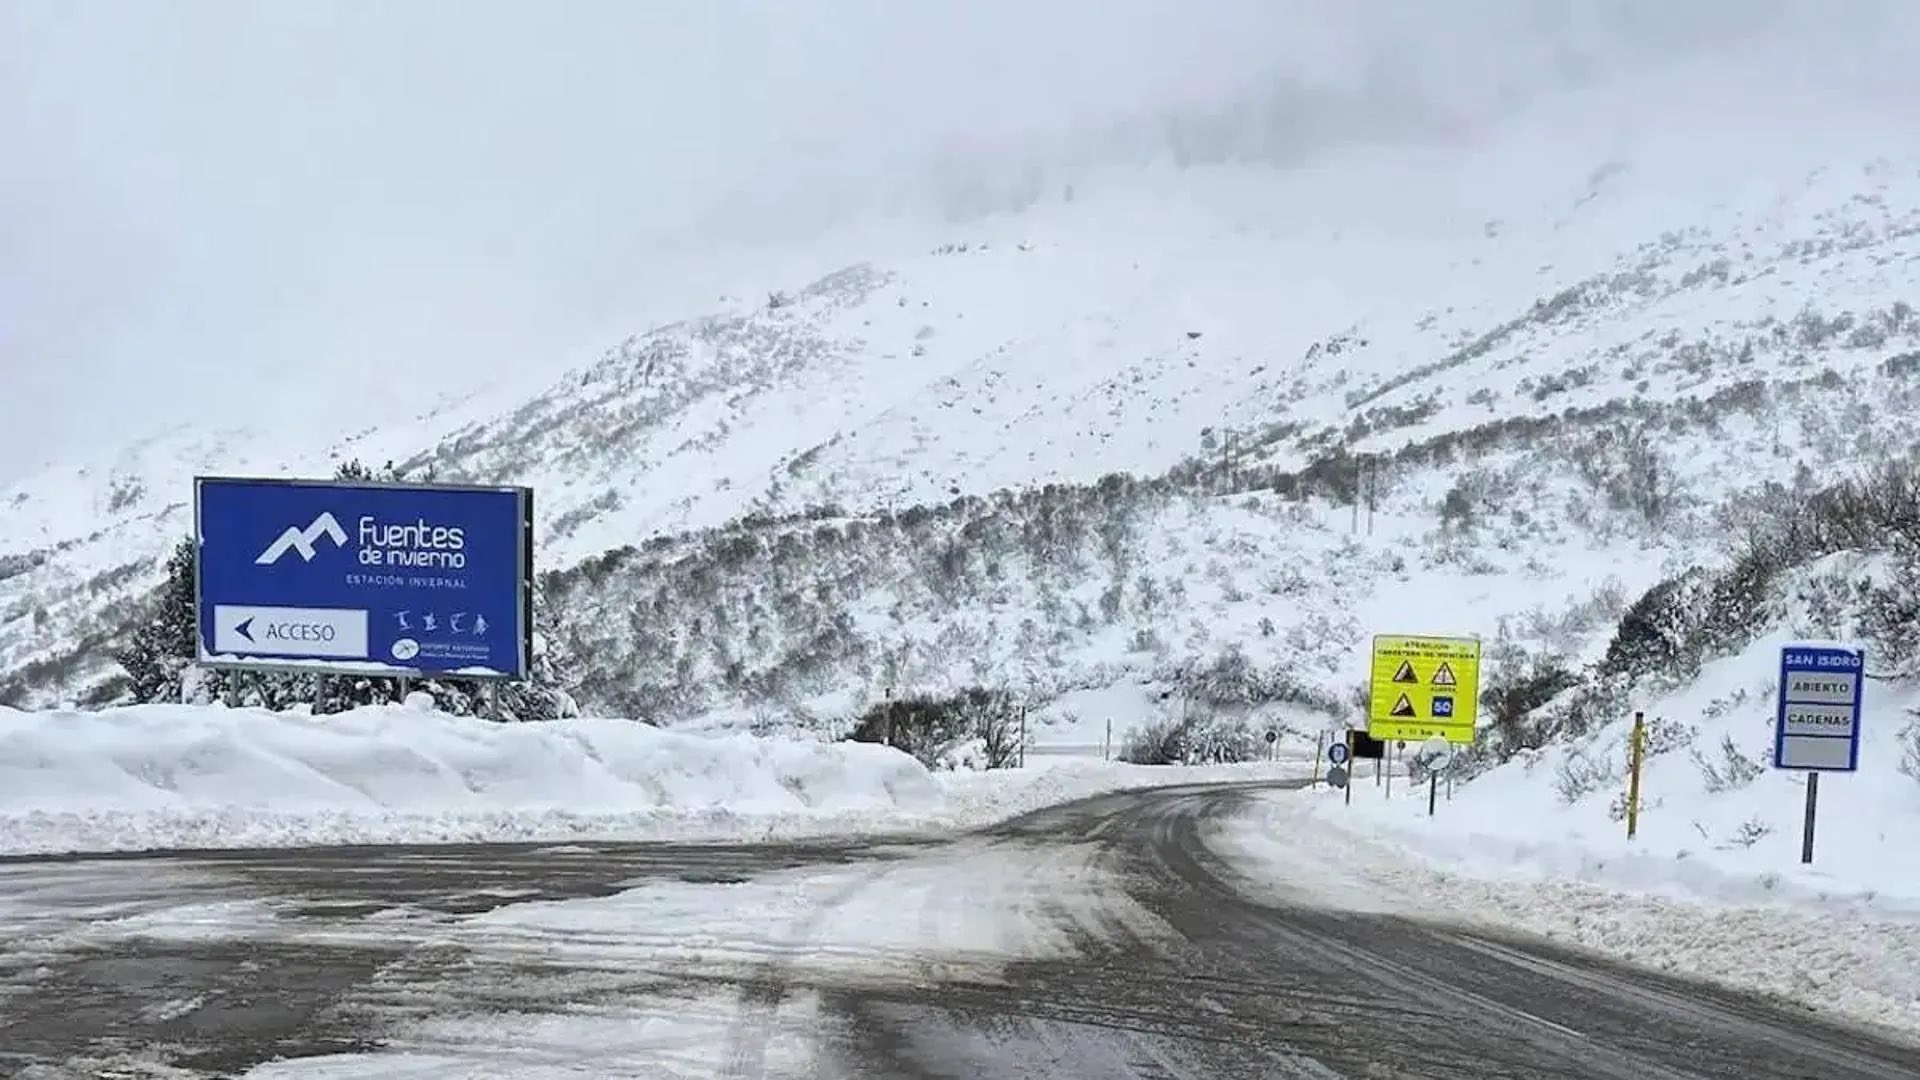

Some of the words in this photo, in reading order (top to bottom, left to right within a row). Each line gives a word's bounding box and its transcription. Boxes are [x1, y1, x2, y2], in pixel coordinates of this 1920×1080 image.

[360, 516, 464, 549] Fuentes
[359, 545, 382, 564] de
[387, 547, 465, 568] invierno
[409, 577, 466, 588] INVERNAL
[266, 623, 336, 642] ACCESO
[1785, 655, 1814, 665] SAN
[1817, 655, 1861, 667] ISIDRO
[1793, 682, 1849, 693] ABIERTO
[1433, 701, 1451, 713] 50
[1788, 714, 1850, 726] CADENAS
